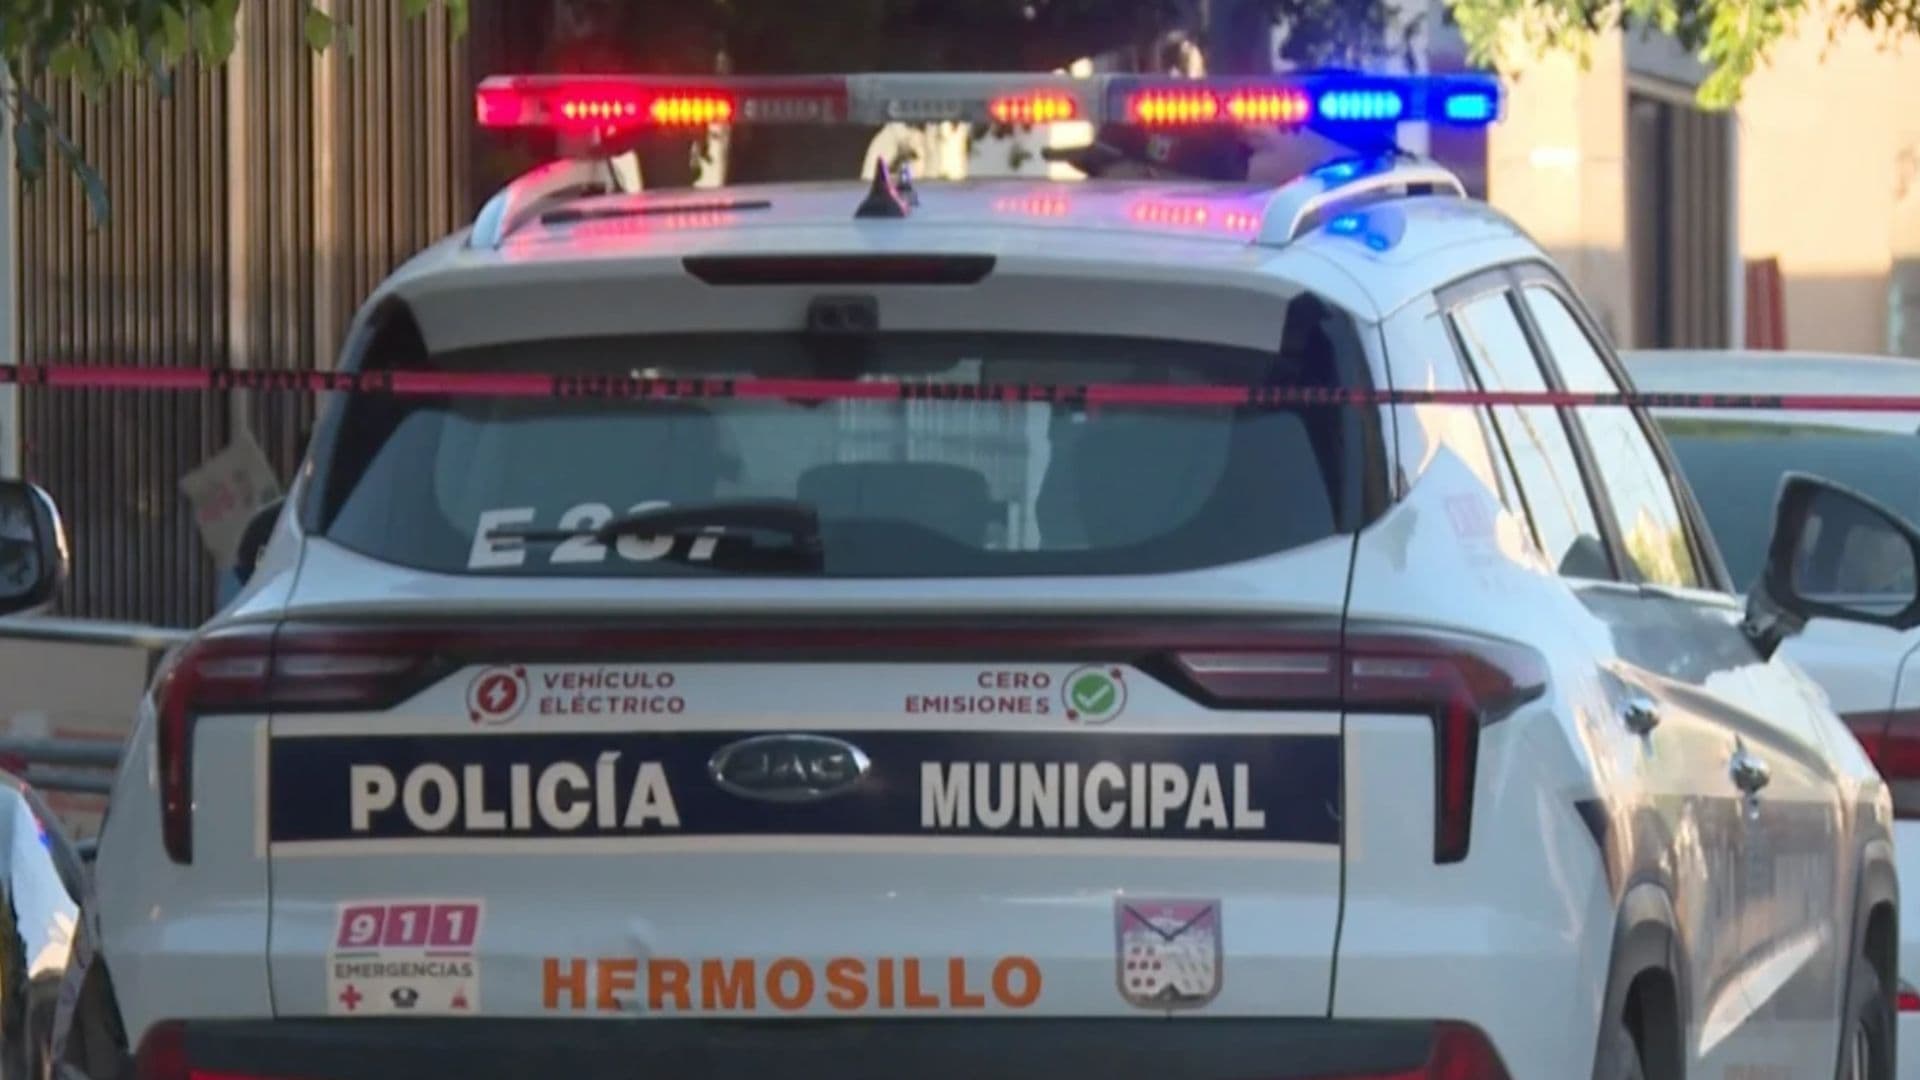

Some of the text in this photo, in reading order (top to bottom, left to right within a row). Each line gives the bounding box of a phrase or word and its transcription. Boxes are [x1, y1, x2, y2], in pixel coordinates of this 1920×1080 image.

[467, 506, 536, 568] E
[543, 668, 675, 689] VEHÍCULO
[977, 671, 1051, 689] CERO
[539, 692, 685, 714] ELÉCTRICO
[904, 696, 1051, 714] EMISIONES
[349, 752, 1266, 831] POLICÍA MUNICIPAL
[347, 909, 465, 944] 911
[334, 961, 474, 979] EMERGENCIAS
[541, 955, 1043, 1010] HERMOSILLO
